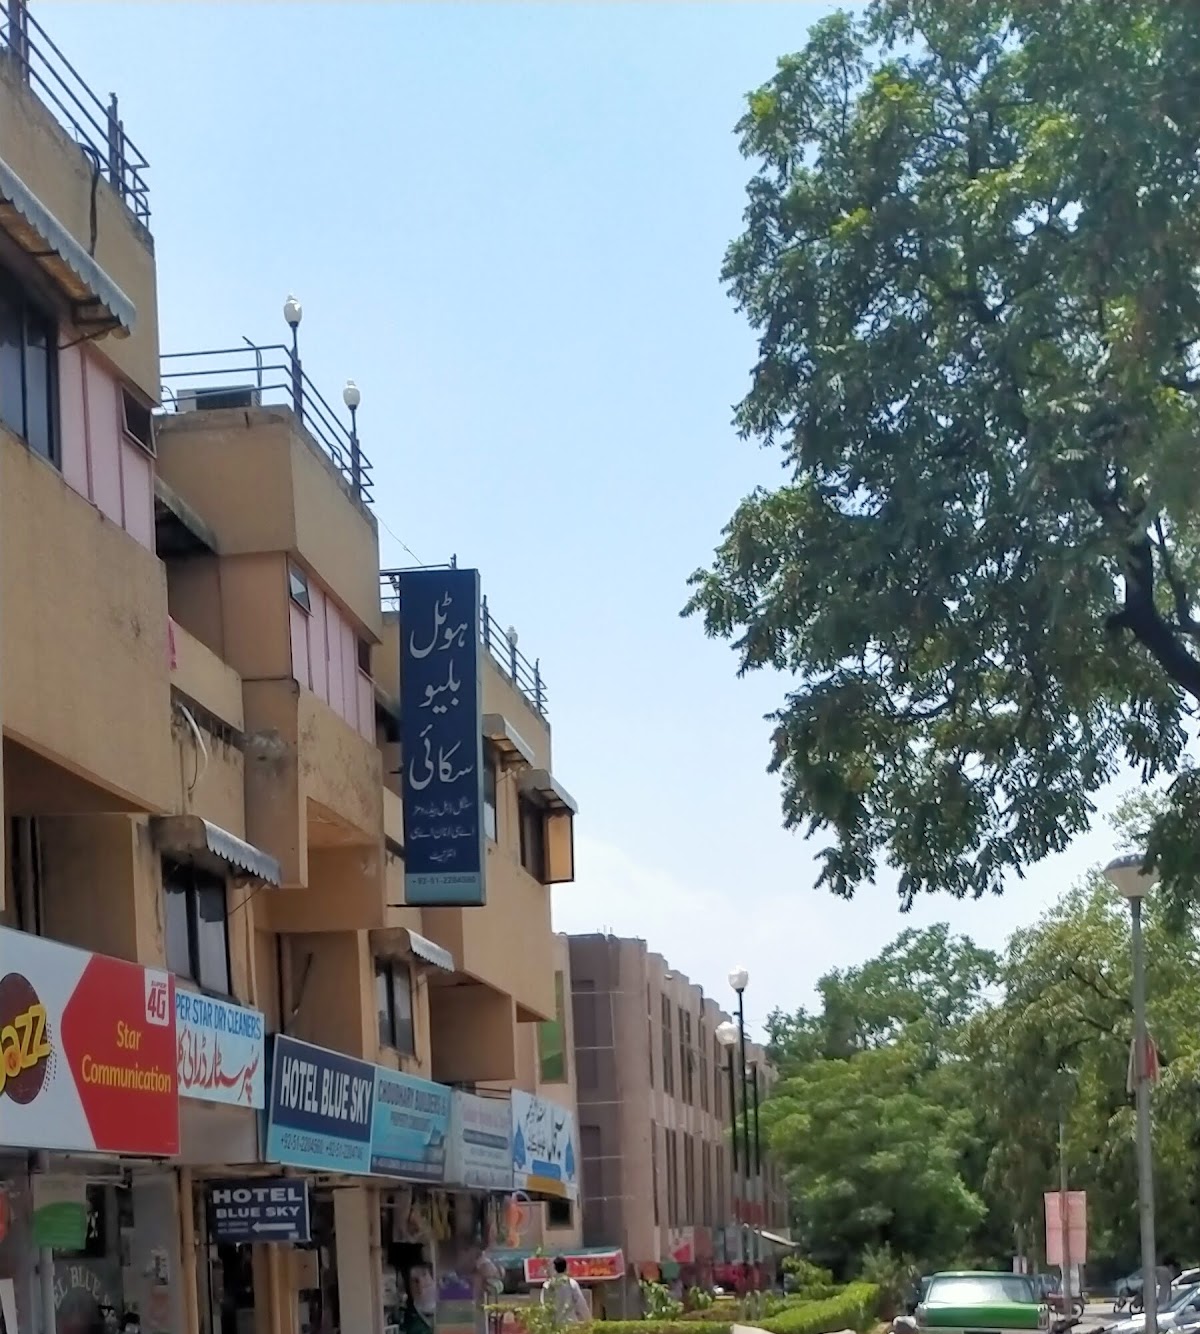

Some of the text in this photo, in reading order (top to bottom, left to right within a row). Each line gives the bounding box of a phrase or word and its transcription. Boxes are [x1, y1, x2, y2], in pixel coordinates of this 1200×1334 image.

[409, 590, 468, 659] ہوٹل
[418, 659, 461, 714] بلیو
[409, 723, 474, 791] سکائی
[147, 987, 167, 1020] 4G
[176, 993, 261, 1040] PER STAR DRY CLEANERS
[117, 1020, 141, 1050] Star
[82, 1053, 171, 1093] Communication
[280, 1055, 373, 1125] HOTEL BLUE SKY
[212, 1187, 303, 1204] HOTEL
[216, 1206, 300, 1219] BLUE SKY
